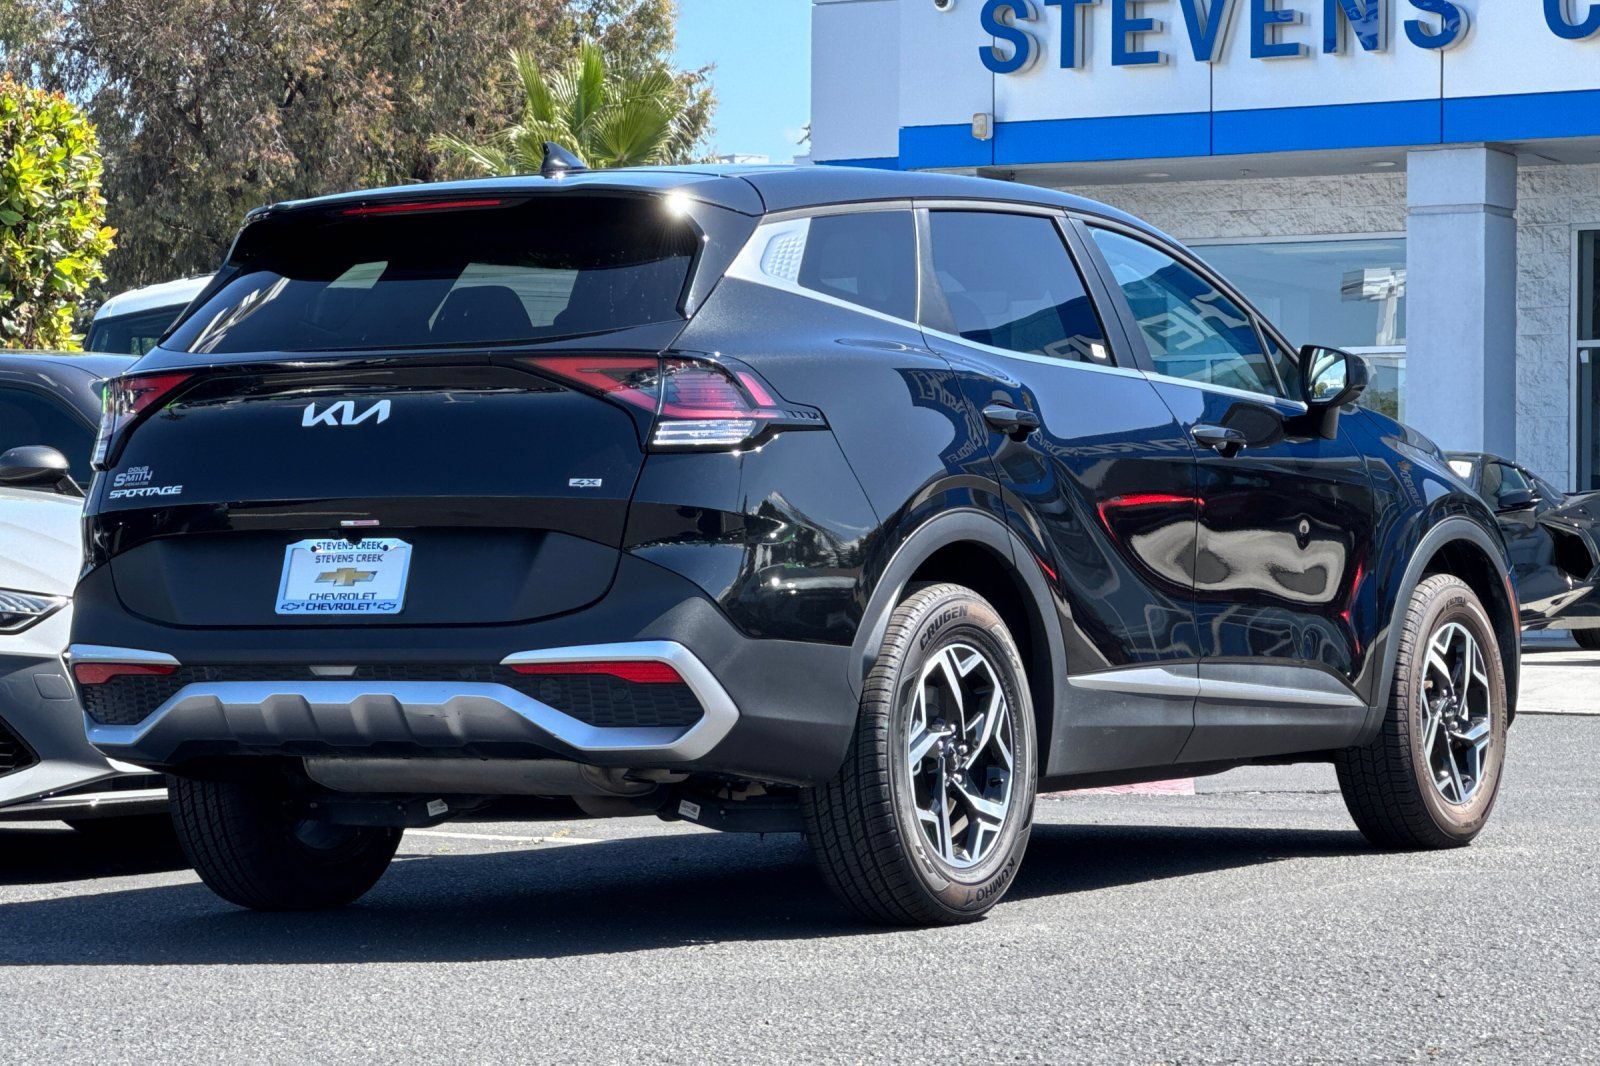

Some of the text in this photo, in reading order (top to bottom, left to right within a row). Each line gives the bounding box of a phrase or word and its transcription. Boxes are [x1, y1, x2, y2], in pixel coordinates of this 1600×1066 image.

[979, 0, 1466, 74] STEVENS
[302, 399, 391, 426] KIA
[127, 466, 149, 474] DOUG
[114, 471, 153, 487] SMITH
[109, 485, 183, 499] SPORTAGE
[316, 541, 384, 550] STEVENS CREEK
[315, 553, 384, 563] STEVENS CREEK
[309, 592, 377, 600] CHEVROLET
[306, 602, 371, 611] CHEVROLET
[920, 605, 969, 651] CRUGEN
[975, 857, 1016, 902] KUMHO
